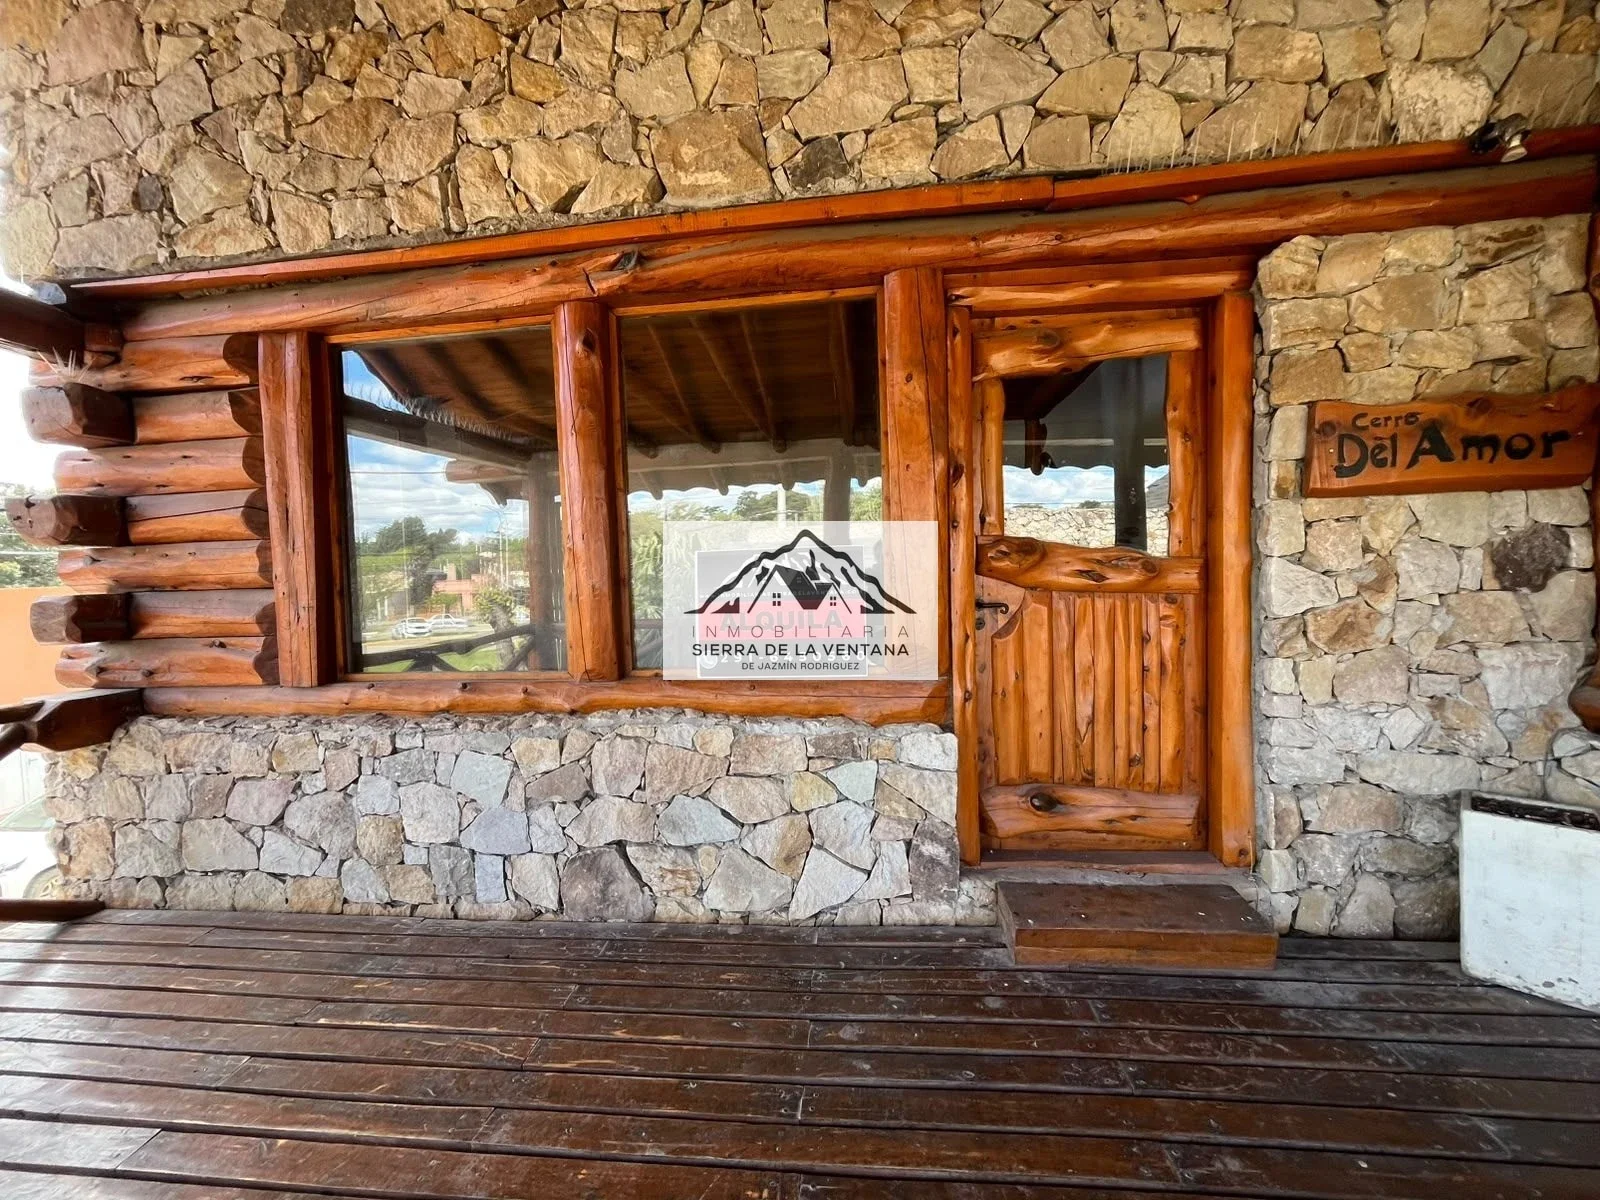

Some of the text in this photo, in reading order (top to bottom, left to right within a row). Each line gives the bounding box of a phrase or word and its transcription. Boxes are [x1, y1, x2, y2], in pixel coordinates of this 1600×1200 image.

[1351, 411, 1422, 431] Cerro
[1333, 420, 1572, 478] Del Amor
[720, 610, 843, 631] ALQUILA
